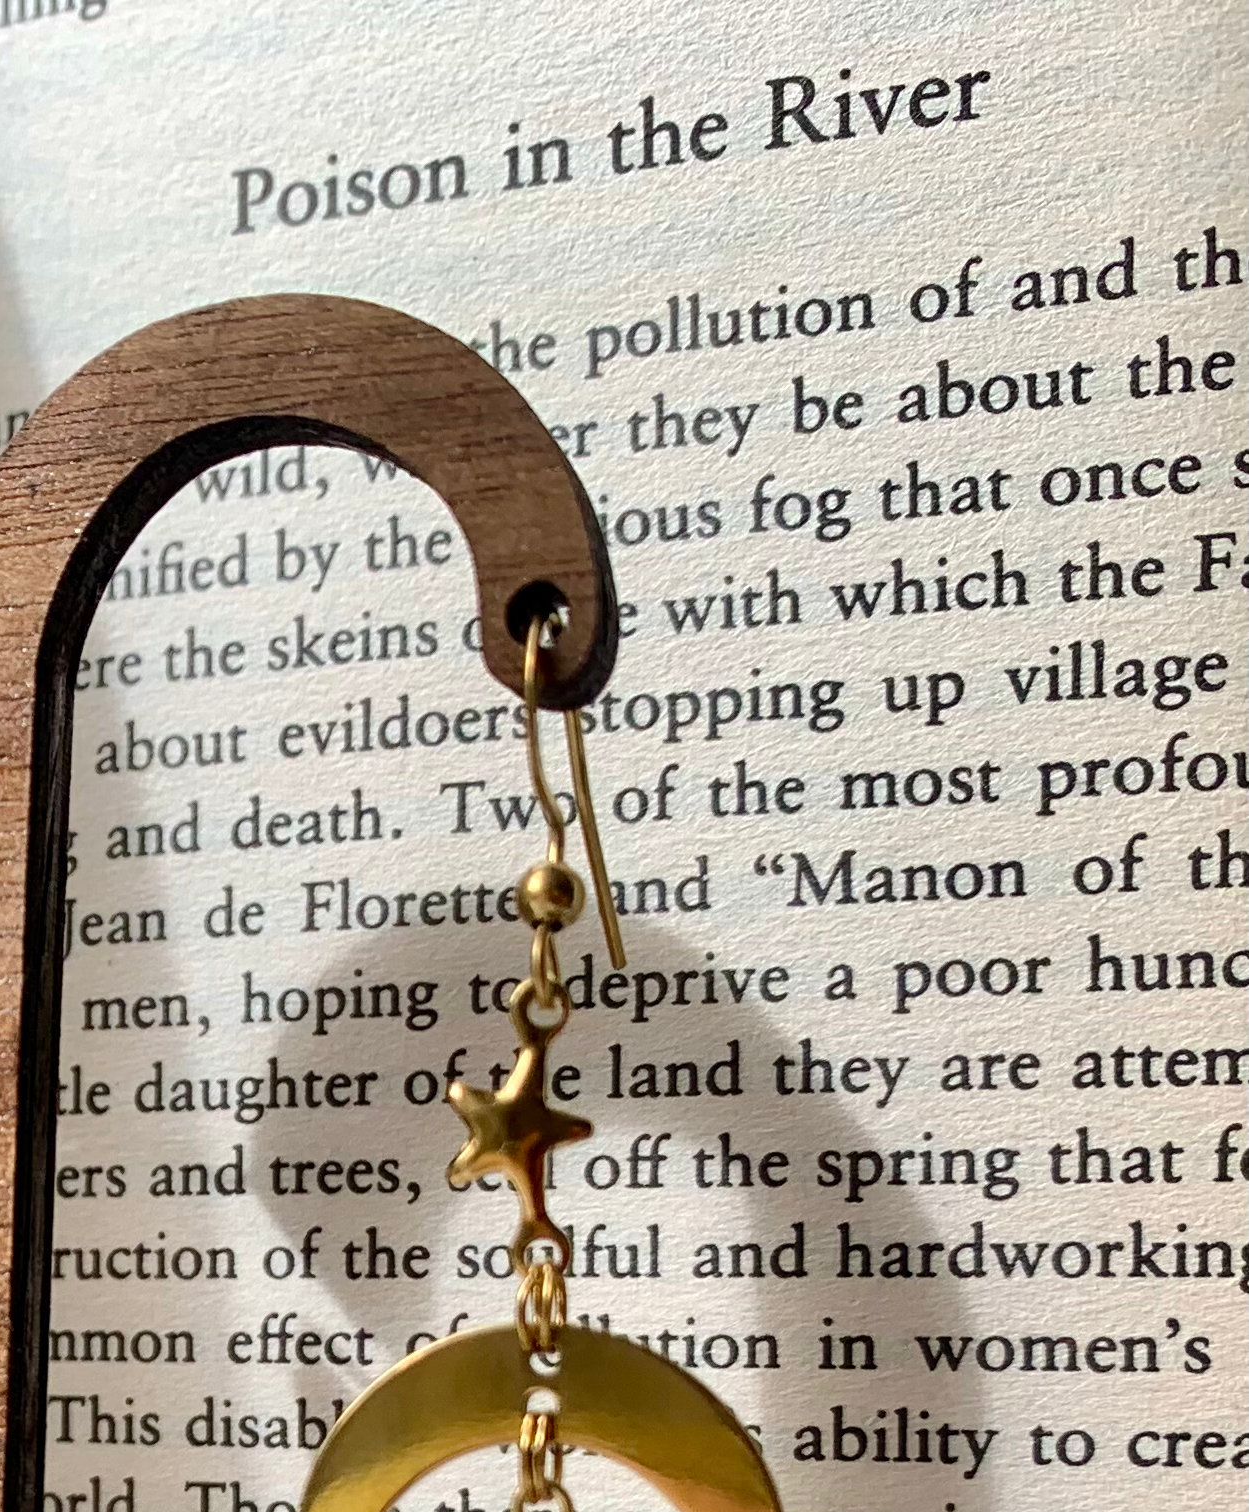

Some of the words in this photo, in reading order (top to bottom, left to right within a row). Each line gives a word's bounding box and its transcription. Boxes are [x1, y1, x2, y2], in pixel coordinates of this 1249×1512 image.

[231, 153, 470, 236] Poison
[606, 94, 729, 176] the
[763, 67, 992, 151] River
[584, 284, 877, 381] pollution
[200, 449, 329, 502] wild,
[626, 391, 761, 459] they
[791, 374, 865, 435] be
[896, 358, 1098, 424] about
[1126, 334, 1236, 400] the
[363, 514, 453, 574] the
[748, 473, 853, 544] fog
[1039, 453, 1203, 508] once
[267, 610, 439, 672] skeins
[661, 567, 803, 635] with
[828, 548, 1031, 622] which
[1057, 539, 1166, 604] the
[94, 720, 248, 775] about
[279, 693, 533, 759] evildoers
[579, 668, 846, 745] stopping
[880, 671, 966, 727] up
[1003, 638, 1229, 713] village
[230, 786, 404, 851] death.
[611, 762, 681, 825] of
[838, 759, 1003, 811] most
[203, 884, 266, 939] de
[81, 994, 210, 1037] men,
[240, 968, 440, 1037] hoping
[567, 949, 791, 1025] deprive
[824, 963, 858, 1002] a
[891, 956, 1052, 1015] poor
[134, 1056, 380, 1125] daughter
[606, 1038, 745, 1100] land
[771, 1037, 911, 1110] they
[148, 1144, 247, 1198] and
[268, 1155, 422, 1205] trees,
[583, 1132, 672, 1191] off
[816, 1131, 1022, 1204] spring
[263, 1225, 324, 1281] of
[691, 1220, 810, 1280] and
[226, 1311, 375, 1366] effect
[47, 1393, 162, 1447] This
[792, 1404, 1000, 1481] ability
[1028, 1424, 1098, 1467] to
